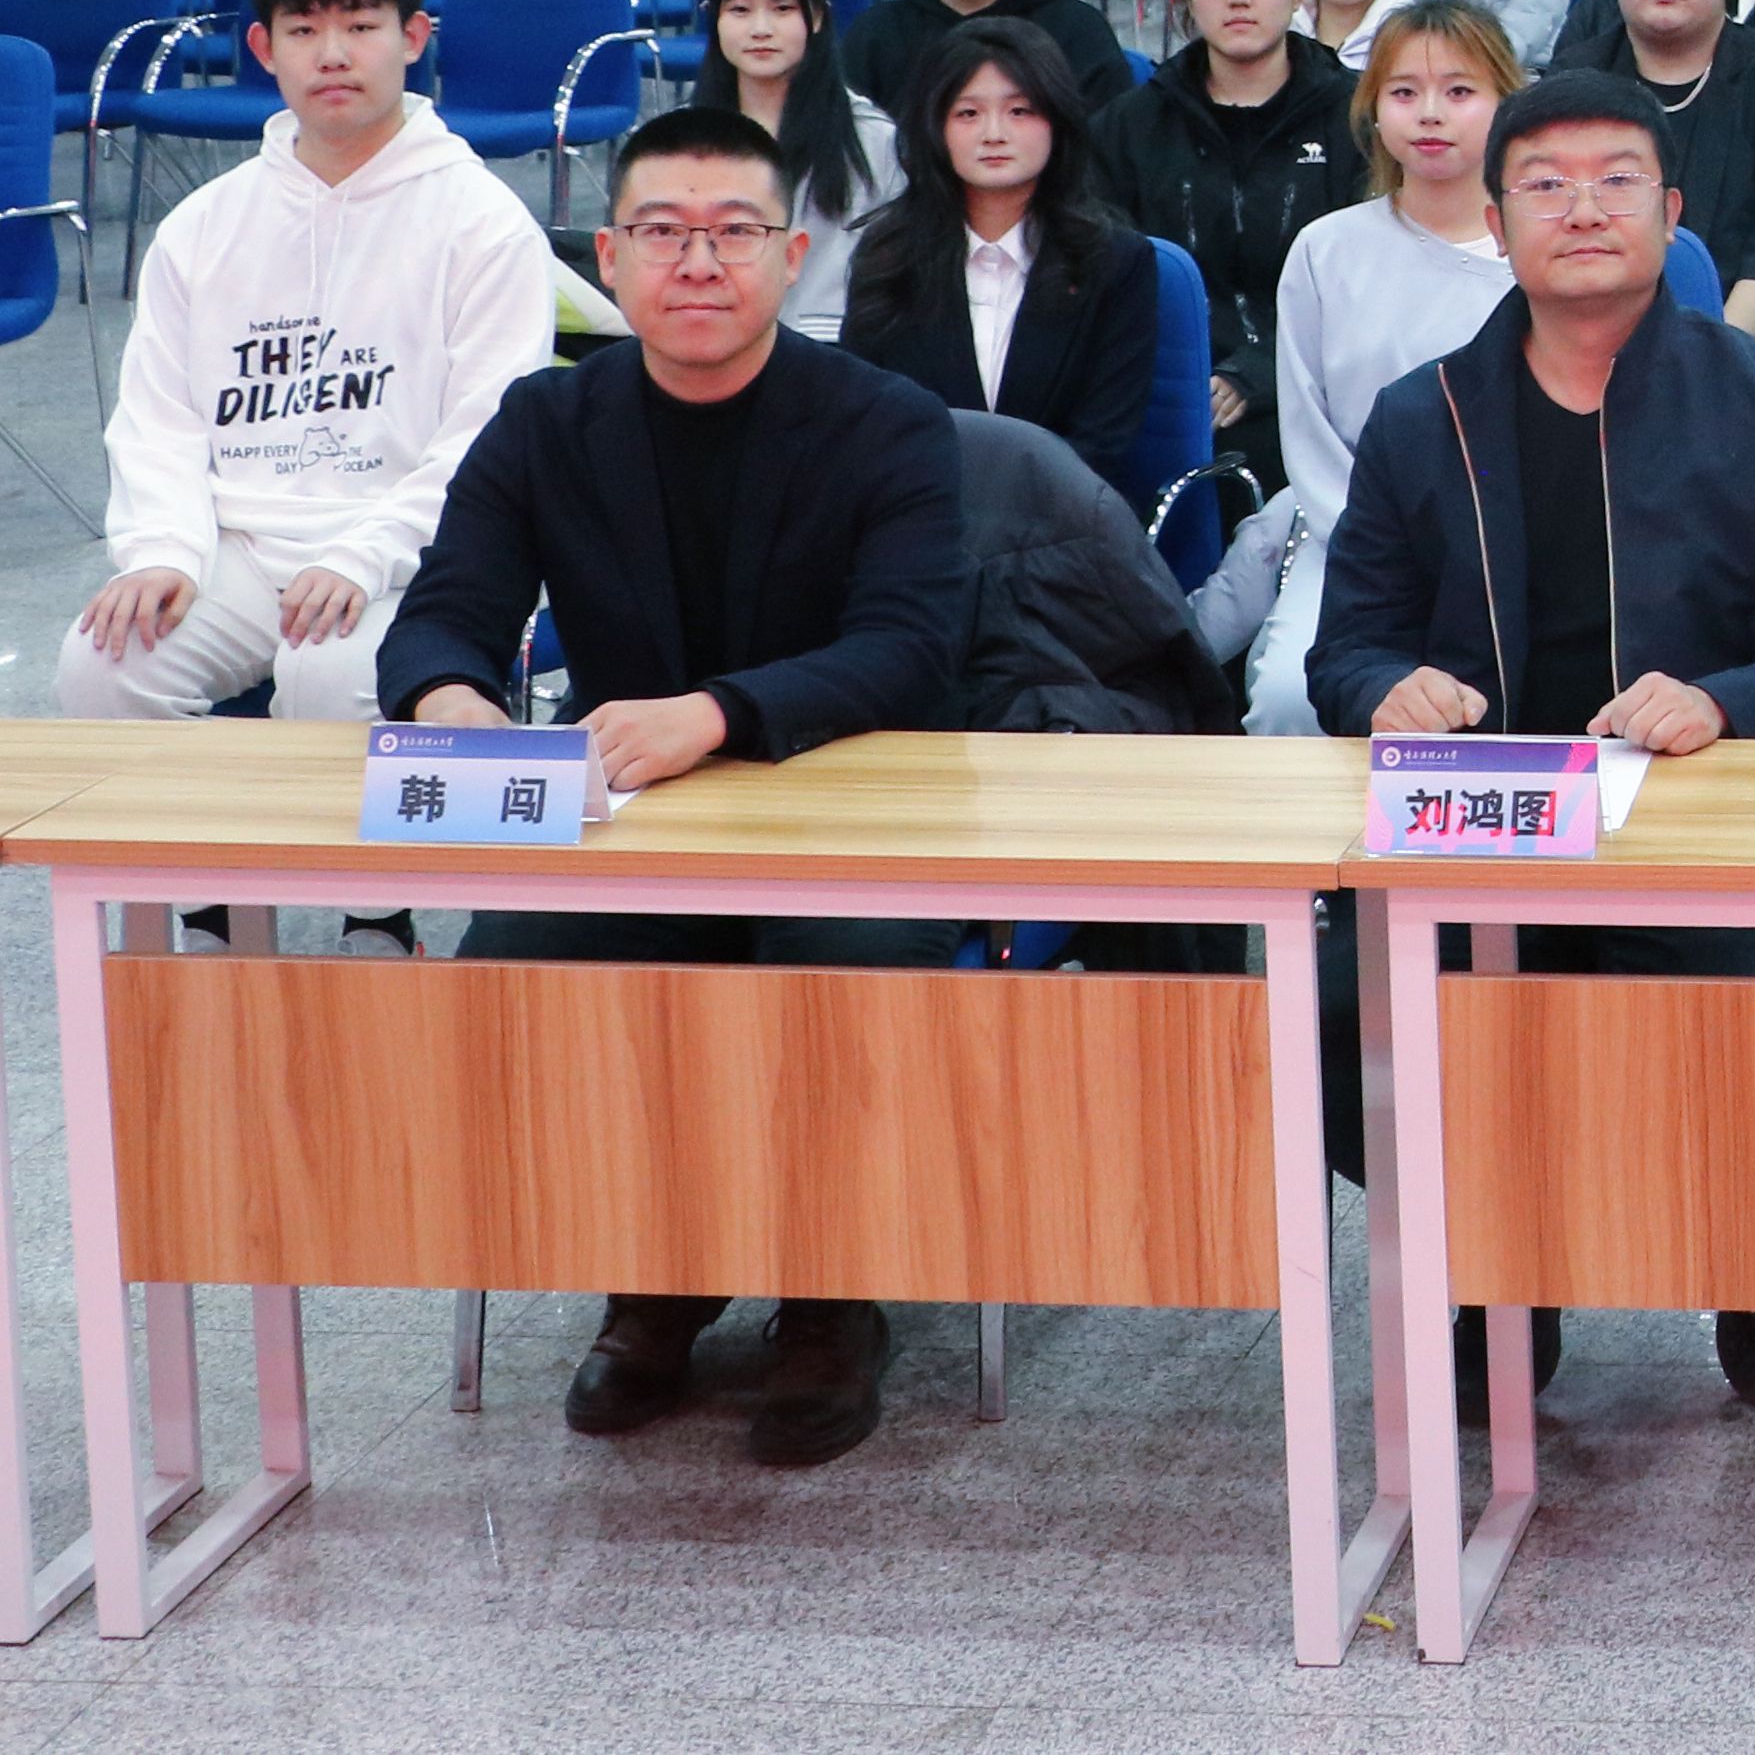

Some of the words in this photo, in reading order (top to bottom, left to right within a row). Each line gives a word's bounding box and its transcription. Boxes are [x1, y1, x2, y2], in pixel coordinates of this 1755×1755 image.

[232, 328, 337, 378] THEY
[340, 346, 379, 366] ARE
[215, 364, 395, 427] DILIGENT
[263, 444, 299, 458] EVERY
[275, 462, 297, 475] DAY
[343, 456, 384, 472] OCEAN
[1405, 788, 1556, 837] 刘鸿图
